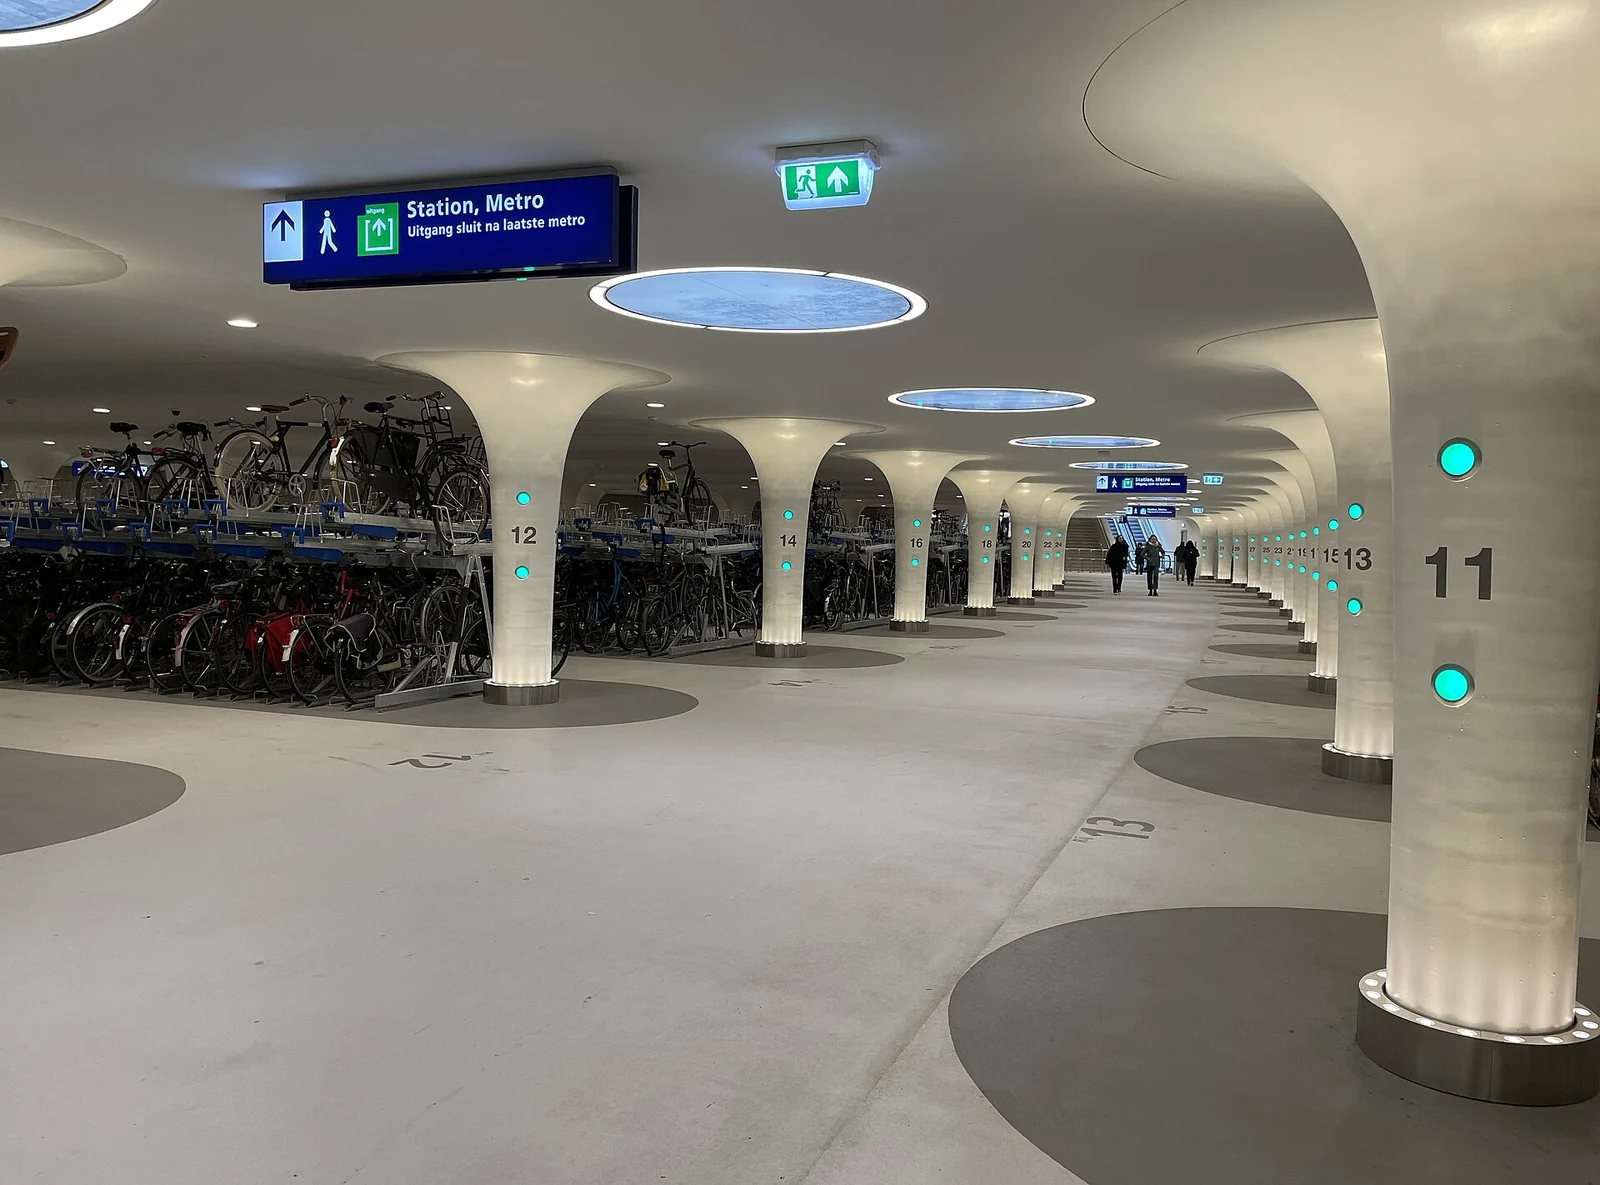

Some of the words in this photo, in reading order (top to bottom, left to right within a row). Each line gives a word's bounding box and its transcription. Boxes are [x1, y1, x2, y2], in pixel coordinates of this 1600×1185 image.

[407, 197, 479, 218] Station,
[486, 193, 544, 212] Metro
[407, 225, 453, 239] Uitgang
[456, 221, 482, 234] sluit
[485, 222, 500, 232] na
[503, 218, 545, 231] laatste
[548, 215, 586, 227] metro
[511, 526, 537, 544] 12
[780, 534, 797, 547] 14
[910, 538, 923, 548] 16
[982, 540, 992, 548] 18
[1310, 548, 1319, 559] 1
[1323, 548, 1338, 563] 15
[1344, 547, 1372, 571] 13
[1425, 546, 1493, 600] 11
[1080, 816, 1155, 840] 13
